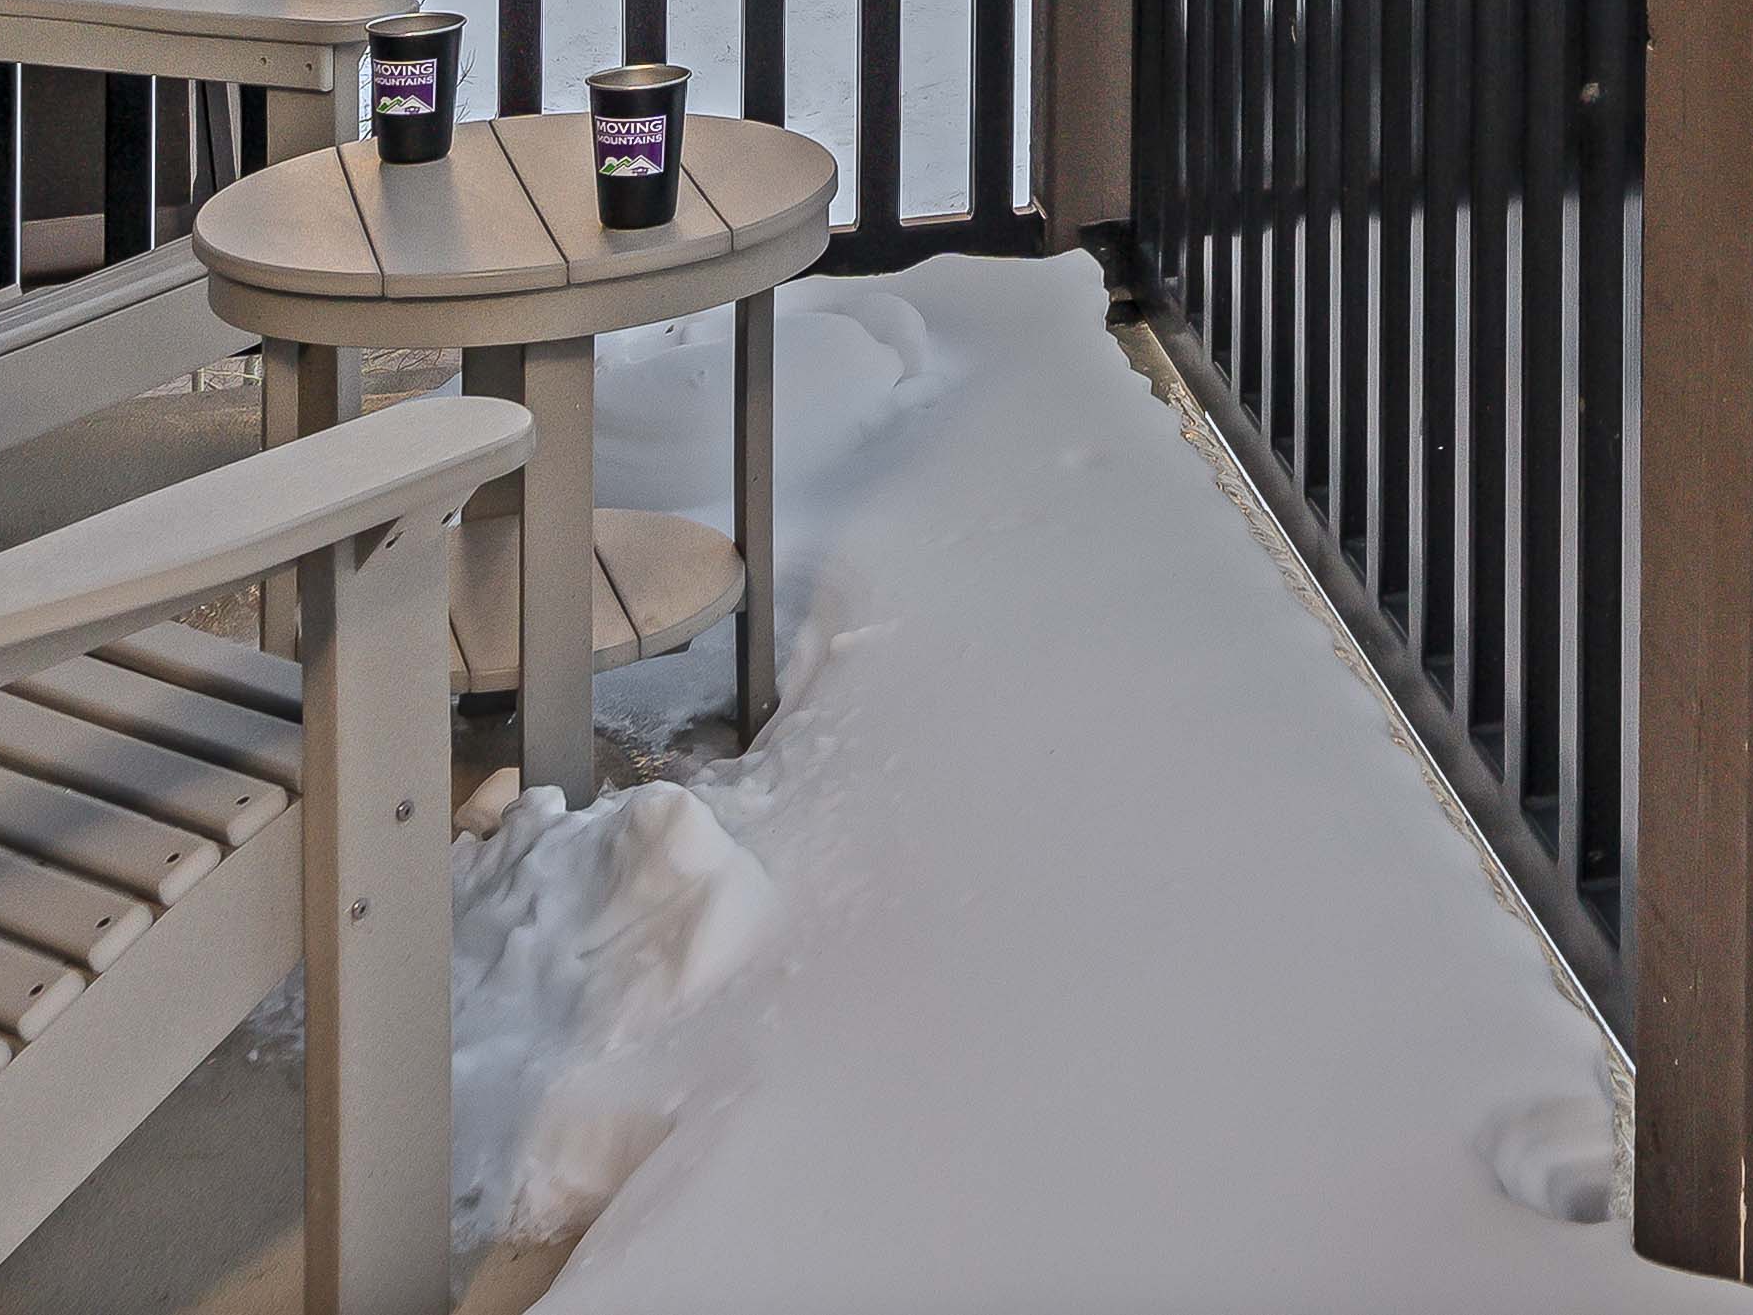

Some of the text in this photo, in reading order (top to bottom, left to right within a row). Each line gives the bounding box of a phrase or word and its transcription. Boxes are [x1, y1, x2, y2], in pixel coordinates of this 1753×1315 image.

[374, 63, 433, 76] MOVING
[596, 120, 663, 134] MOVING
[597, 133, 663, 146] MOUNTAINS
